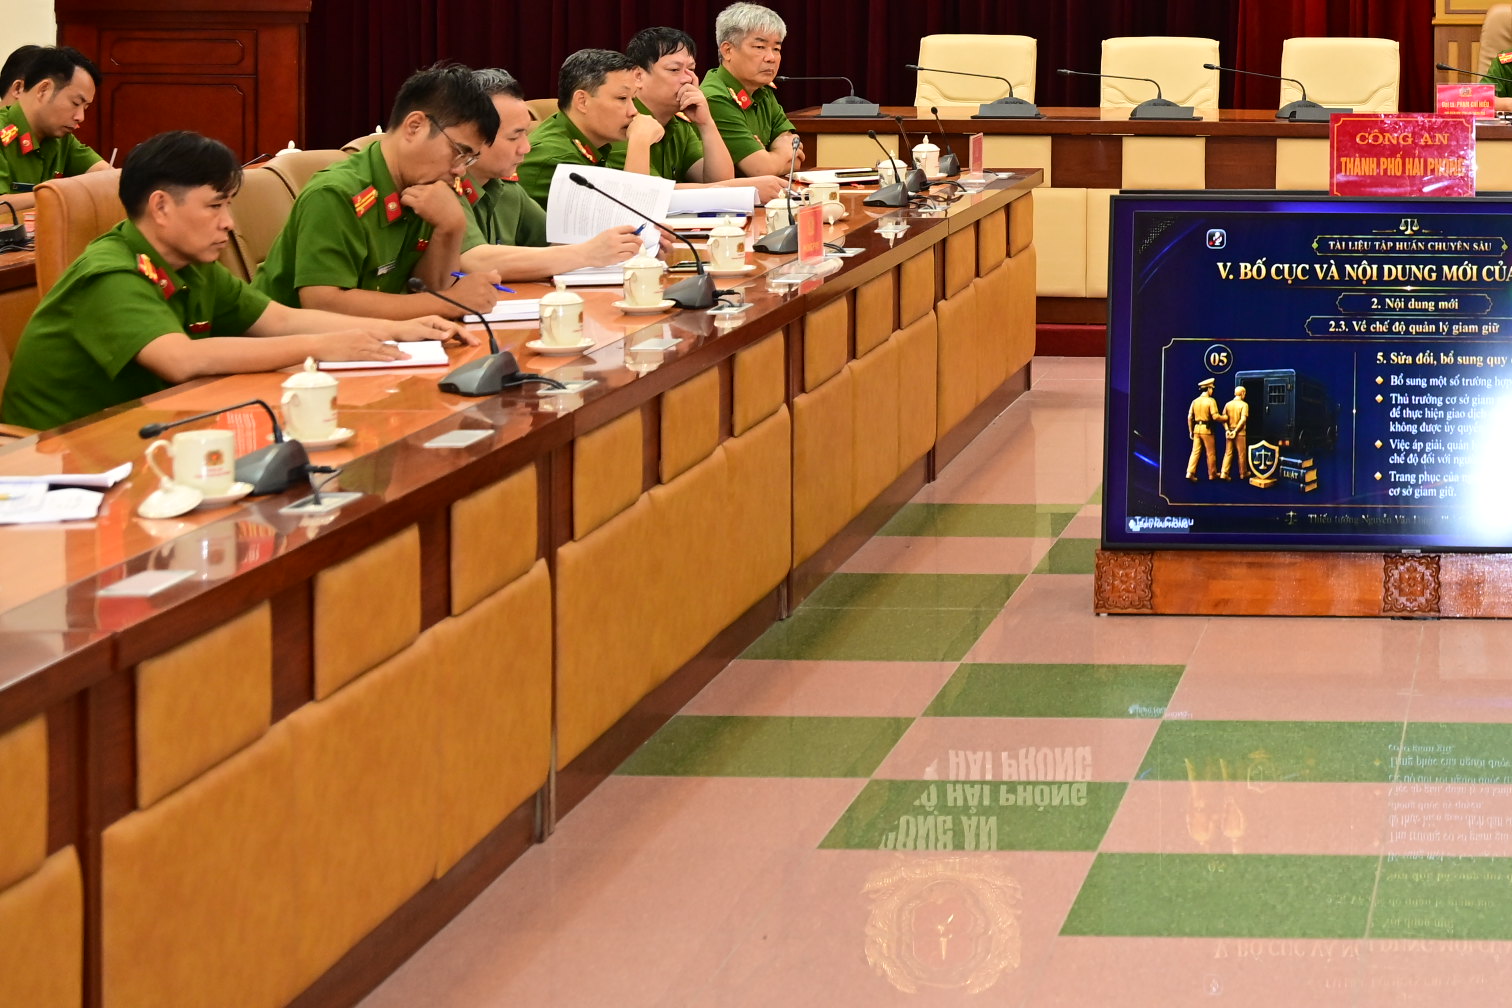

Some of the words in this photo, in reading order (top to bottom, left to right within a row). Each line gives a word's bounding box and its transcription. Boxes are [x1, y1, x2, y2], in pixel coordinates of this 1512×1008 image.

[1356, 129, 1413, 145] CÔNG
[1421, 133, 1449, 145] AN
[1340, 154, 1376, 176] THÀNH
[1380, 151, 1402, 177] PHỐ
[1405, 150, 1424, 177] HẢI
[1329, 240, 1346, 250] TÀI
[1349, 240, 1371, 252] LIỆU
[1374, 240, 1393, 252] TẬP
[1396, 239, 1424, 251] HUẤN
[1428, 240, 1469, 251] CHUYÊN
[1472, 241, 1492, 251] SÂU
[1217, 262, 1234, 280] V.
[1239, 257, 1266, 280] BỐ
[1271, 262, 1309, 284] CỤC
[1314, 258, 1340, 280] VÀ
[1345, 260, 1378, 285] NỘI
[1382, 263, 1437, 282] DUNG
[1441, 261, 1478, 282] MỚI
[1372, 299, 1381, 309] 2.
[1385, 298, 1403, 310] Nội
[1408, 298, 1434, 311] dung
[1438, 299, 1458, 309] mới
[1329, 322, 1348, 332] 2.3.
[1353, 319, 1367, 332] Về
[1371, 319, 1390, 332] chế
[1393, 321, 1406, 335] độ
[1409, 321, 1437, 334] quản
[1439, 321, 1449, 335] lý
[1453, 323, 1479, 335] giam
[1482, 322, 1499, 334] giữ
[1210, 353, 1228, 366] 05
[1377, 352, 1386, 363] 5.
[1390, 352, 1413, 364] Sửa
[1416, 350, 1437, 365] đổi,
[1440, 350, 1454, 364] bổ
[1458, 356, 1483, 367] sung
[1487, 356, 1507, 367] quy
